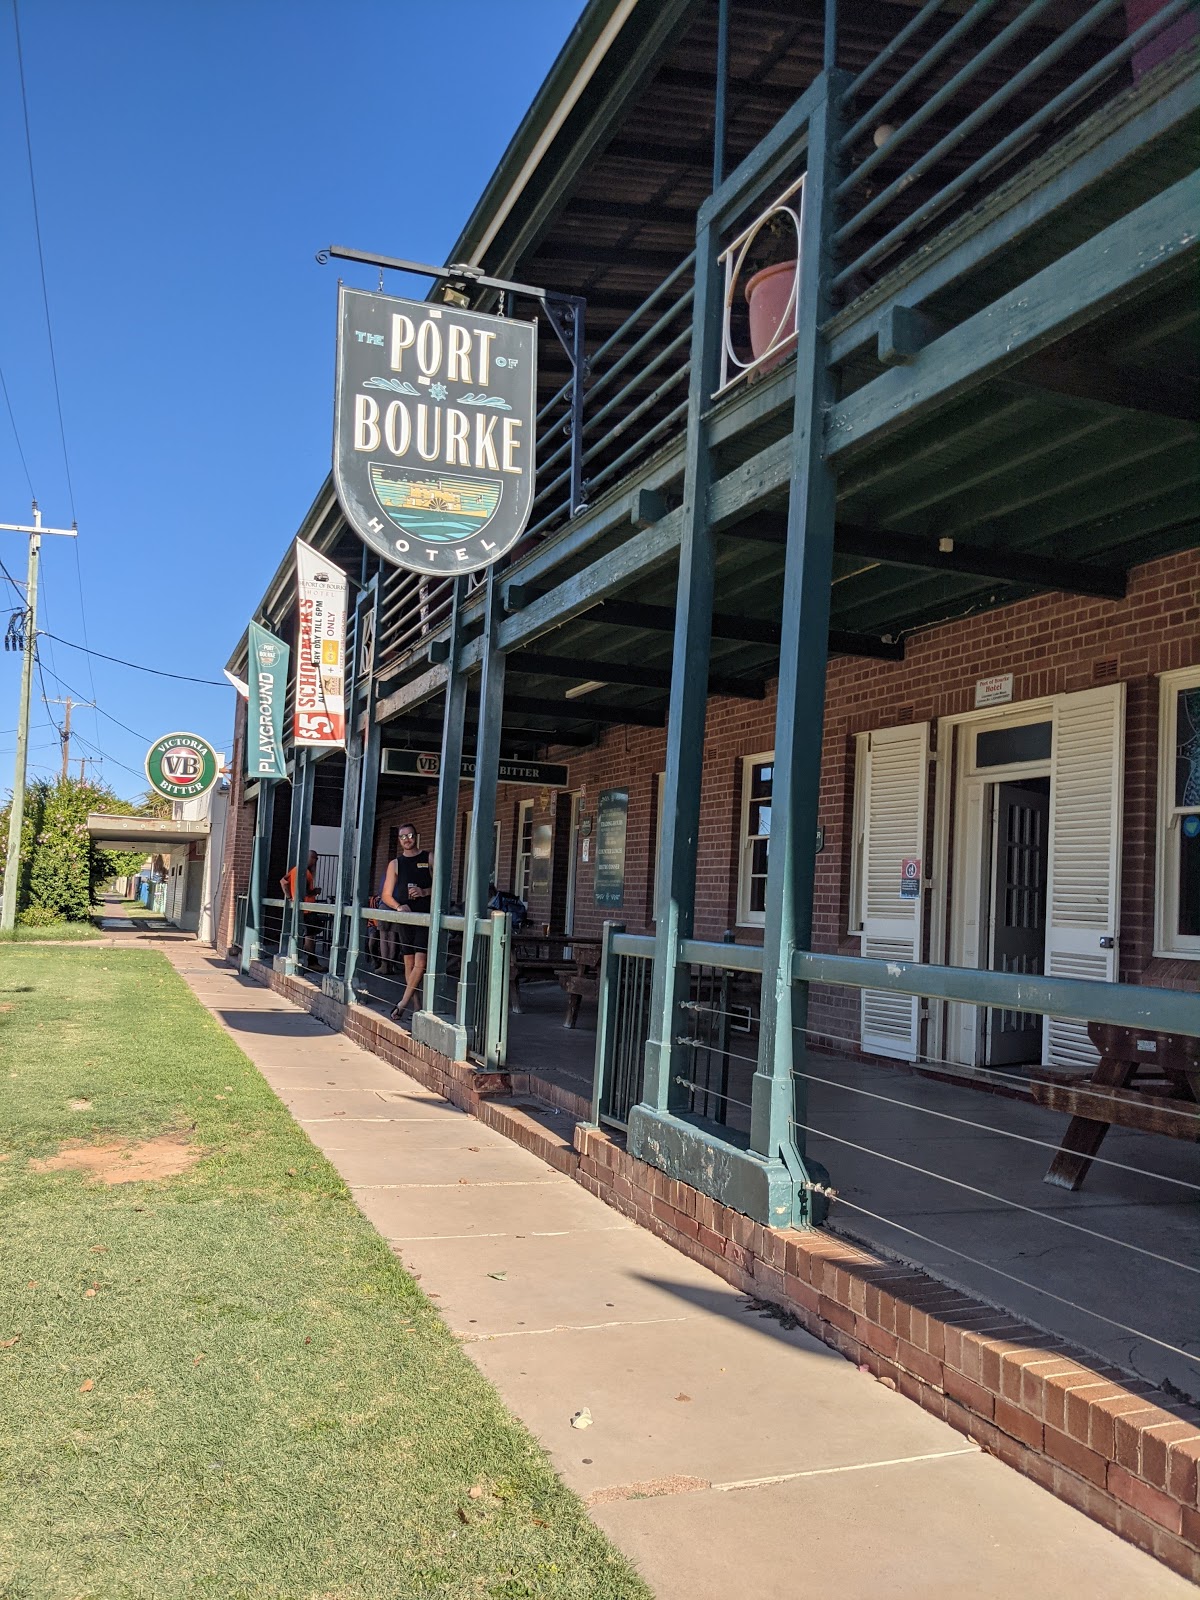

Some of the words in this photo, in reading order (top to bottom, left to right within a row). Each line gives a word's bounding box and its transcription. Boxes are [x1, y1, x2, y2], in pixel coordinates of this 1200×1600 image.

[355, 330, 385, 347] THE
[391, 313, 496, 387] PORT
[495, 356, 518, 369] OF
[354, 393, 522, 474] BOURKE
[367, 517, 496, 562] HOTEL
[307, 590, 335, 598] HOTEL
[315, 600, 323, 617] 6PM
[314, 618, 323, 634] TILL
[326, 611, 336, 637] ONLY
[298, 598, 317, 708] SCHOONERS
[259, 672, 275, 772] PLAYGROUND
[299, 714, 334, 738] $5
[157, 738, 208, 756] VICTORIA
[165, 756, 200, 775] VB
[419, 757, 437, 771] VB
[500, 766, 539, 778] BITTER
[160, 780, 204, 795] BITTER
